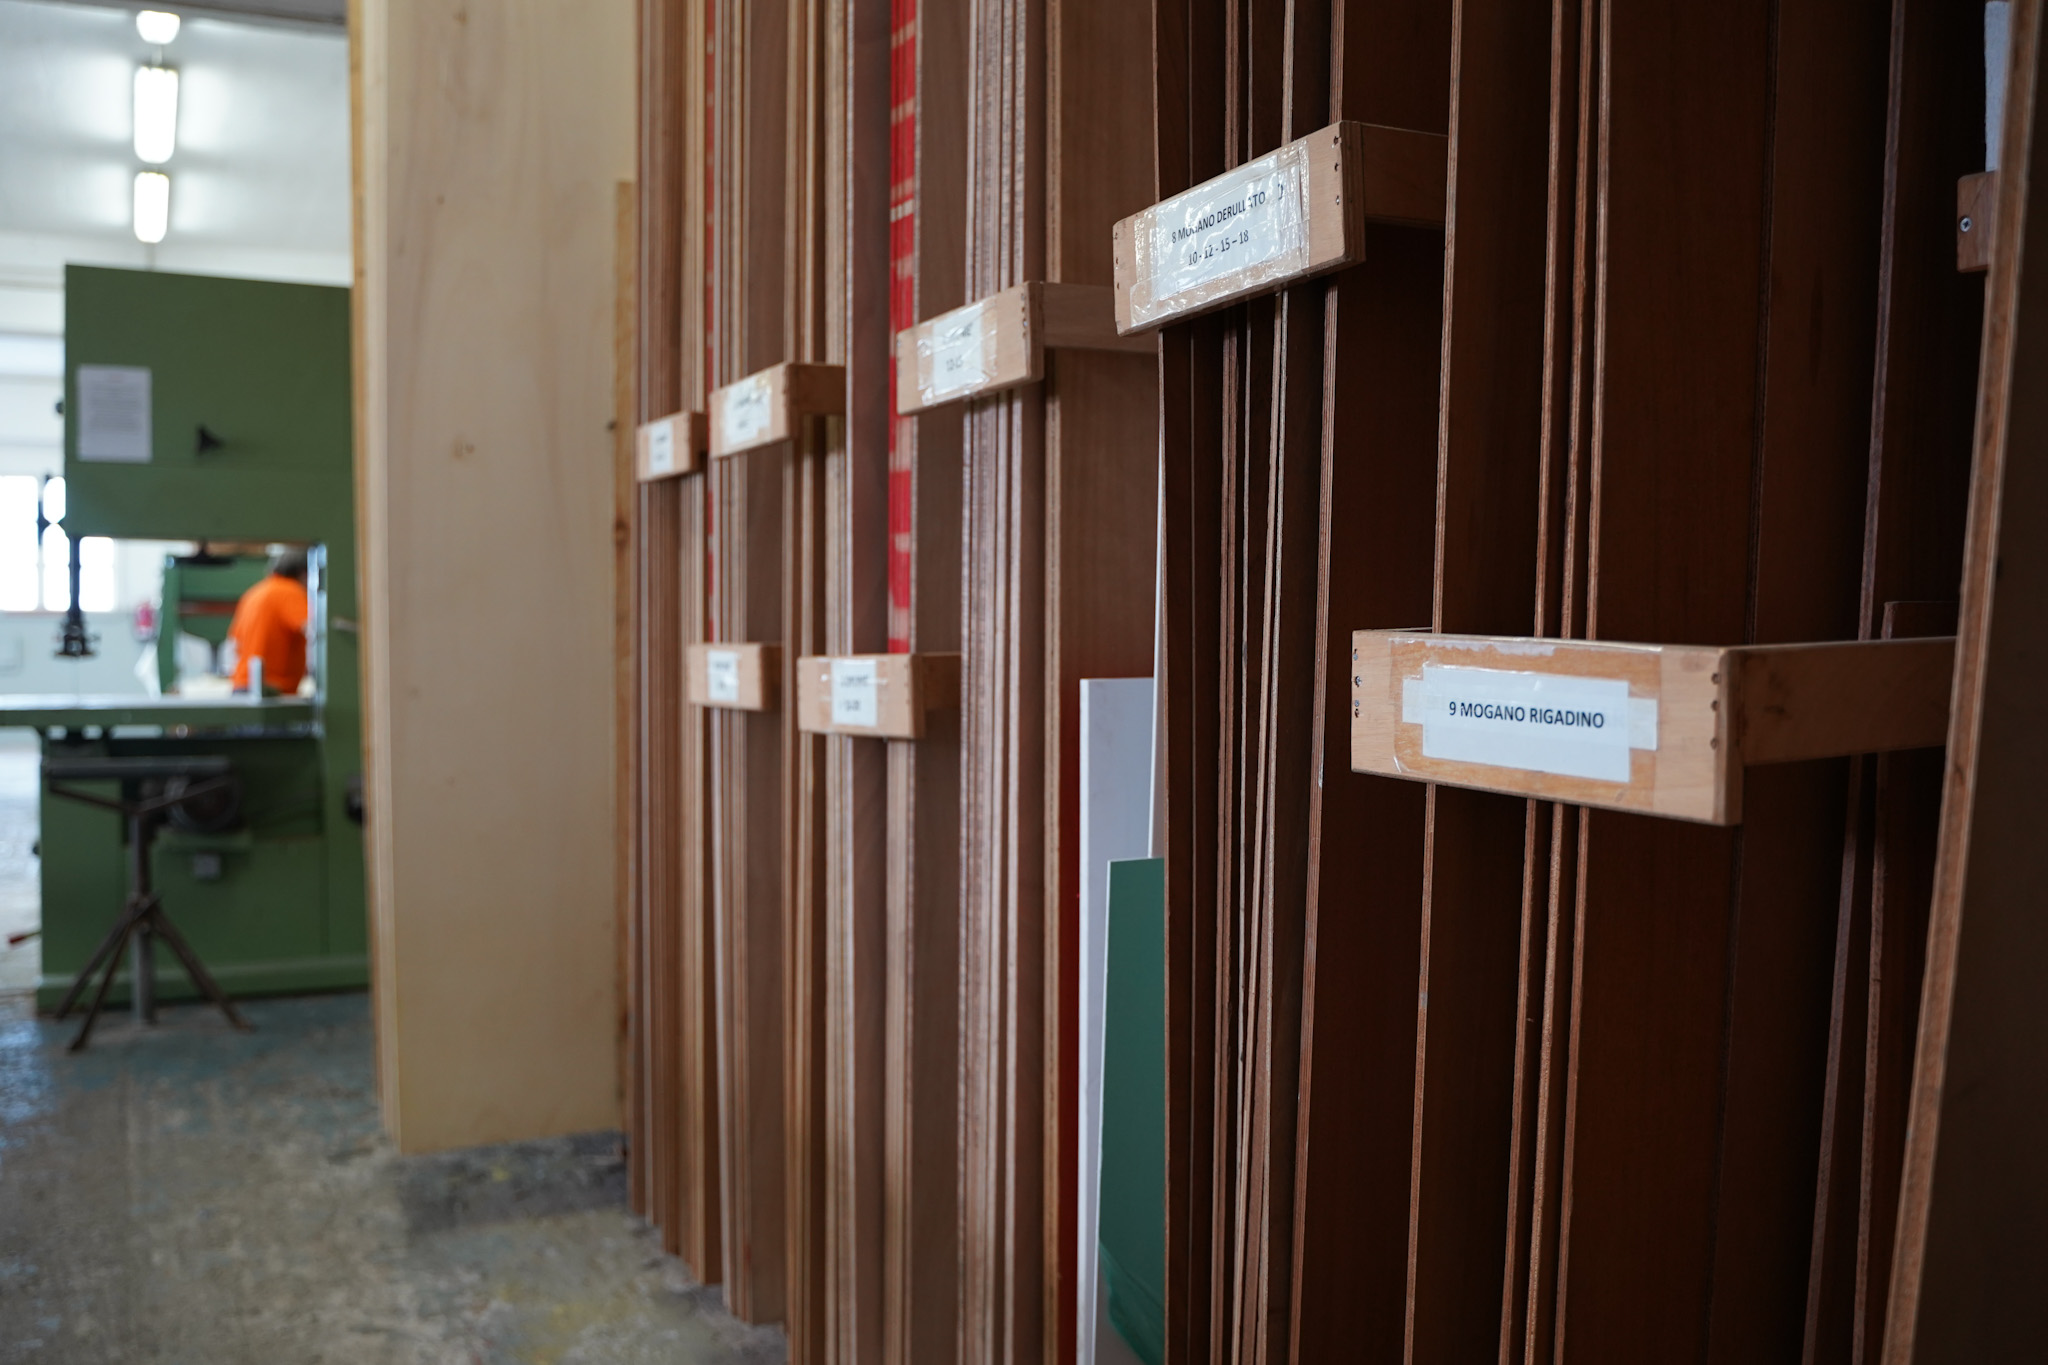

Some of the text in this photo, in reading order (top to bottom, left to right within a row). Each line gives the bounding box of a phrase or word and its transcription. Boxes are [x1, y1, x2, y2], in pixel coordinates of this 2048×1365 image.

[1171, 230, 1177, 244] 8
[1188, 251, 1198, 266] 10
[1204, 244, 1213, 260] 12
[1220, 238, 1231, 253] 15
[1239, 230, 1249, 245] 18
[1449, 701, 1604, 729] 9 MOGANO RIGADINO
